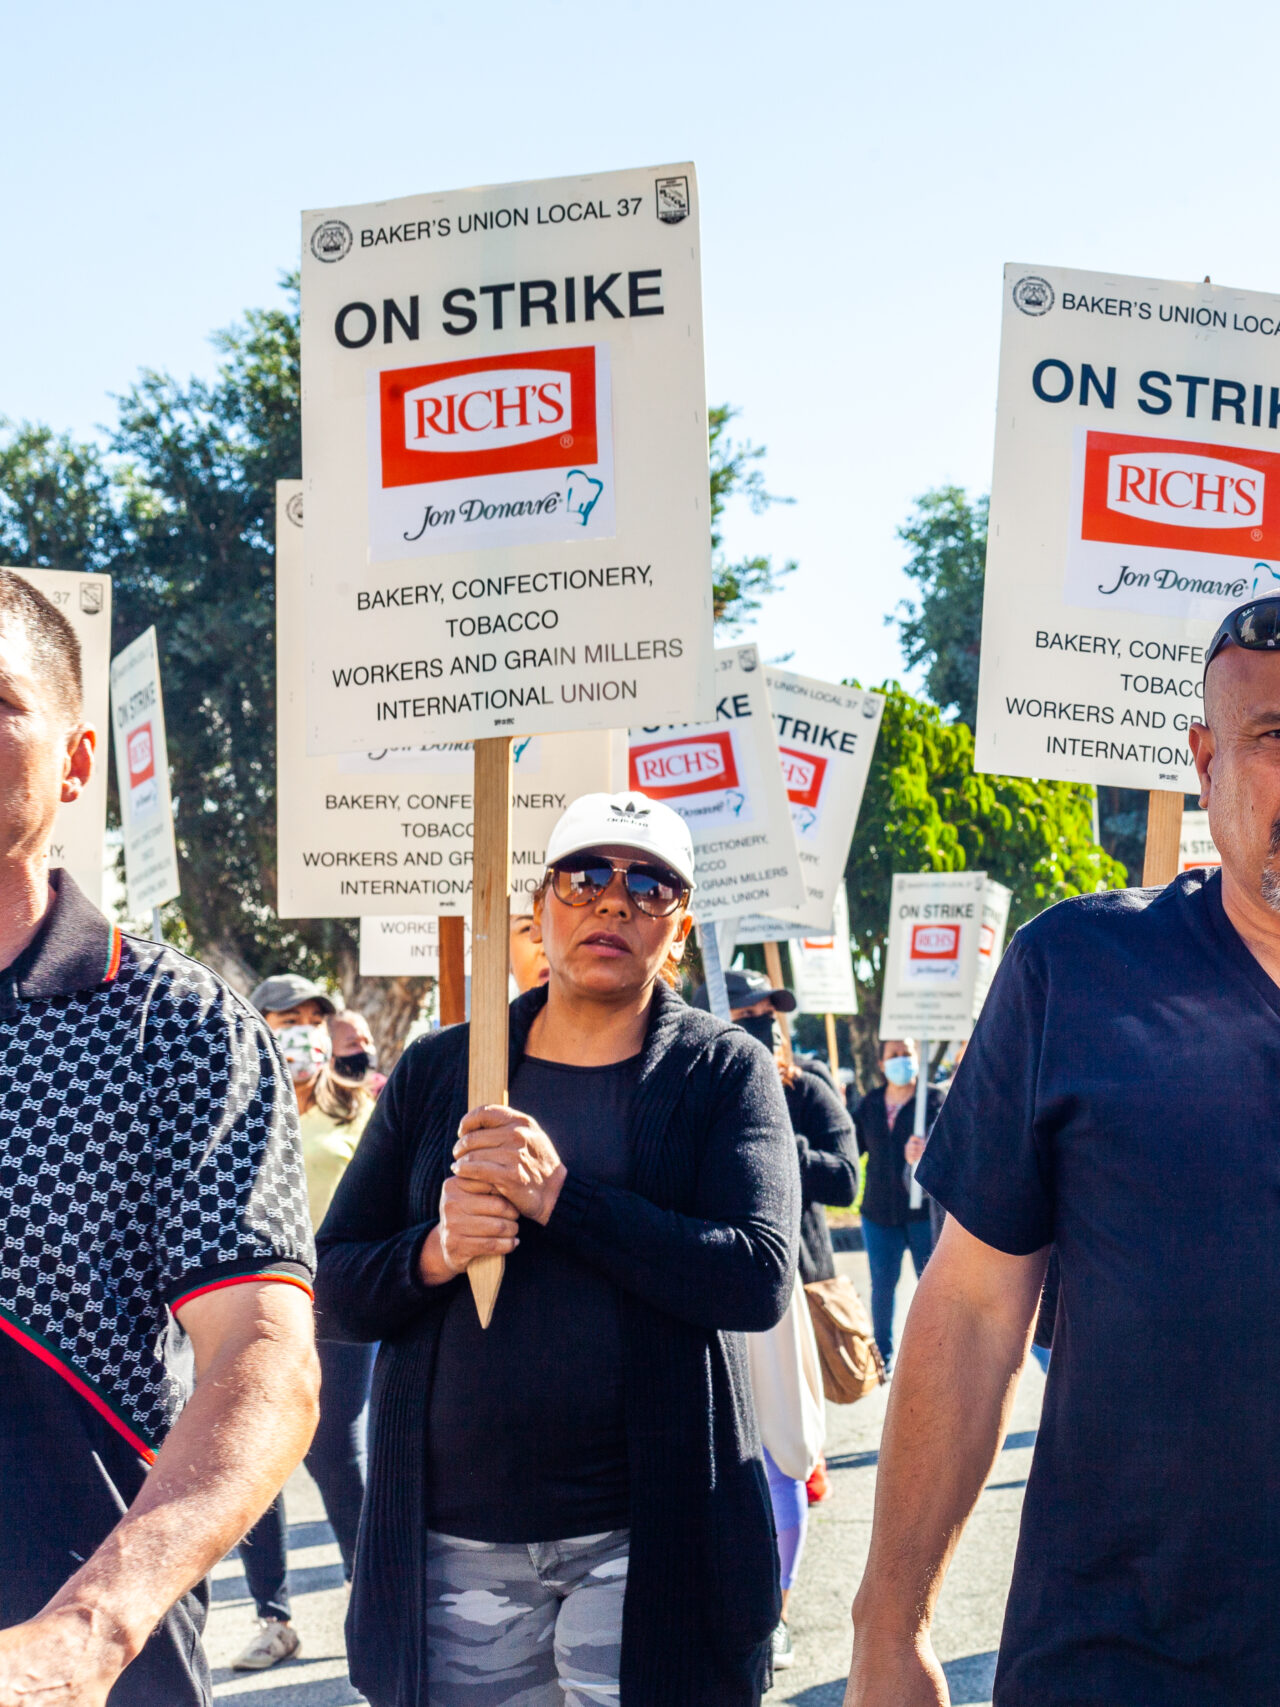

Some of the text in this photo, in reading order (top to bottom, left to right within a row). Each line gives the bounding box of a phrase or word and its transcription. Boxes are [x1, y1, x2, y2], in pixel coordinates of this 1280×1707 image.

[360, 218, 450, 248] BAKER'S
[458, 207, 529, 234] UNION
[537, 199, 611, 224] LOCAL
[616, 197, 643, 216] 37
[334, 268, 665, 349] ON STRIKE
[1062, 292, 1152, 320] BAKER'S
[1159, 304, 1228, 328] UNION
[1031, 357, 1117, 409] ON
[413, 382, 565, 440] RICH'S
[1115, 463, 1257, 517] RICH'S
[403, 503, 456, 542] Jon
[357, 564, 654, 611] BAKERY, CONFECTIONERY,
[1098, 564, 1151, 594] Jon
[52, 591, 71, 604] 37
[445, 609, 559, 638] TOBACCO
[1035, 630, 1122, 660] BAKERY,
[332, 638, 683, 688] WORKERS AND GRAIN MILLERS
[376, 679, 638, 721] INTERNATIONAL UNION
[774, 679, 809, 697] UNION
[810, 689, 843, 707] LOCAL
[1120, 673, 1204, 699] TOBACC
[1006, 696, 1114, 726] WORKERS
[1119, 708, 1166, 729] AND
[772, 714, 859, 754] TRIKE
[642, 748, 720, 782] RICH'S
[1046, 736, 1194, 768] INTERNATION
[325, 794, 401, 811] BAKERY,
[400, 822, 475, 838] TOBACC
[303, 852, 398, 867] WORKERS
[403, 852, 443, 866] AND
[340, 880, 473, 895] INTERNATIONA
[701, 866, 788, 891] GRAIN MILLERS
[731, 888, 770, 903] UNION
[899, 904, 919, 919] ON
[923, 903, 975, 919] STRIKE
[381, 922, 436, 934] WORKE
